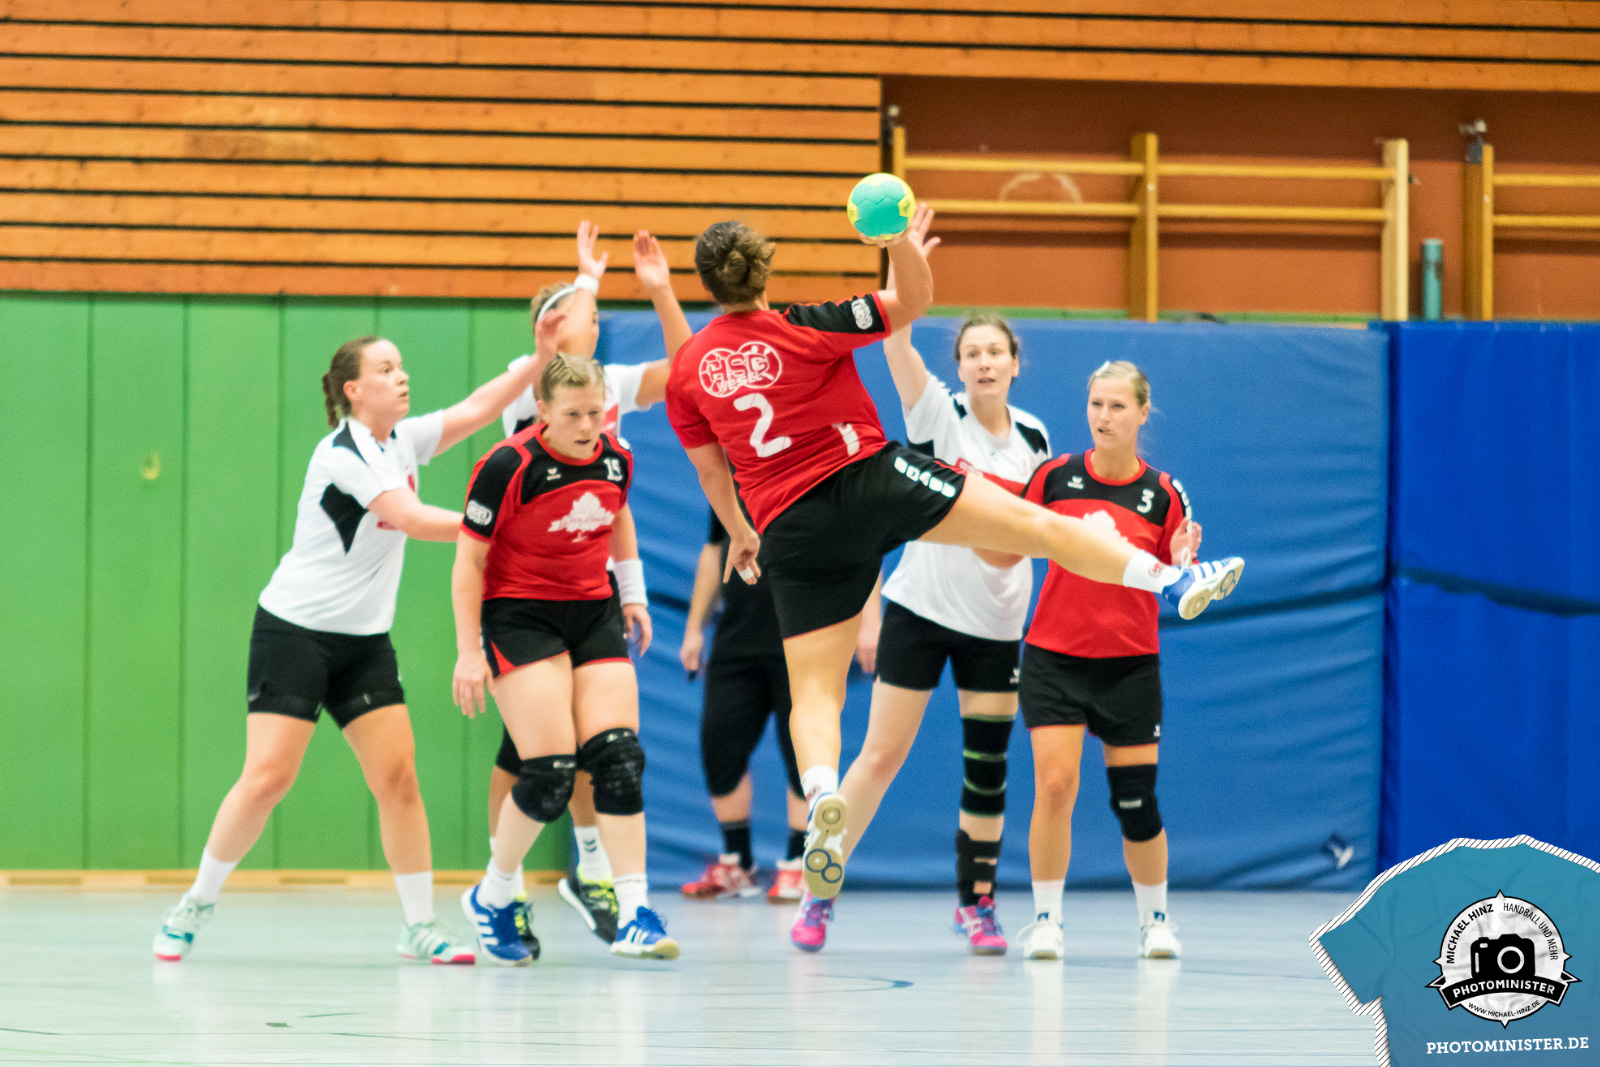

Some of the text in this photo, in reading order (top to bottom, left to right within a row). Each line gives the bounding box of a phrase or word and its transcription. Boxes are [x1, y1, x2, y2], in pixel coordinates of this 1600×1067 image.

[706, 352, 770, 384] HSG
[733, 393, 792, 458] 2
[604, 458, 623, 481] 15
[1137, 489, 1154, 513] 3
